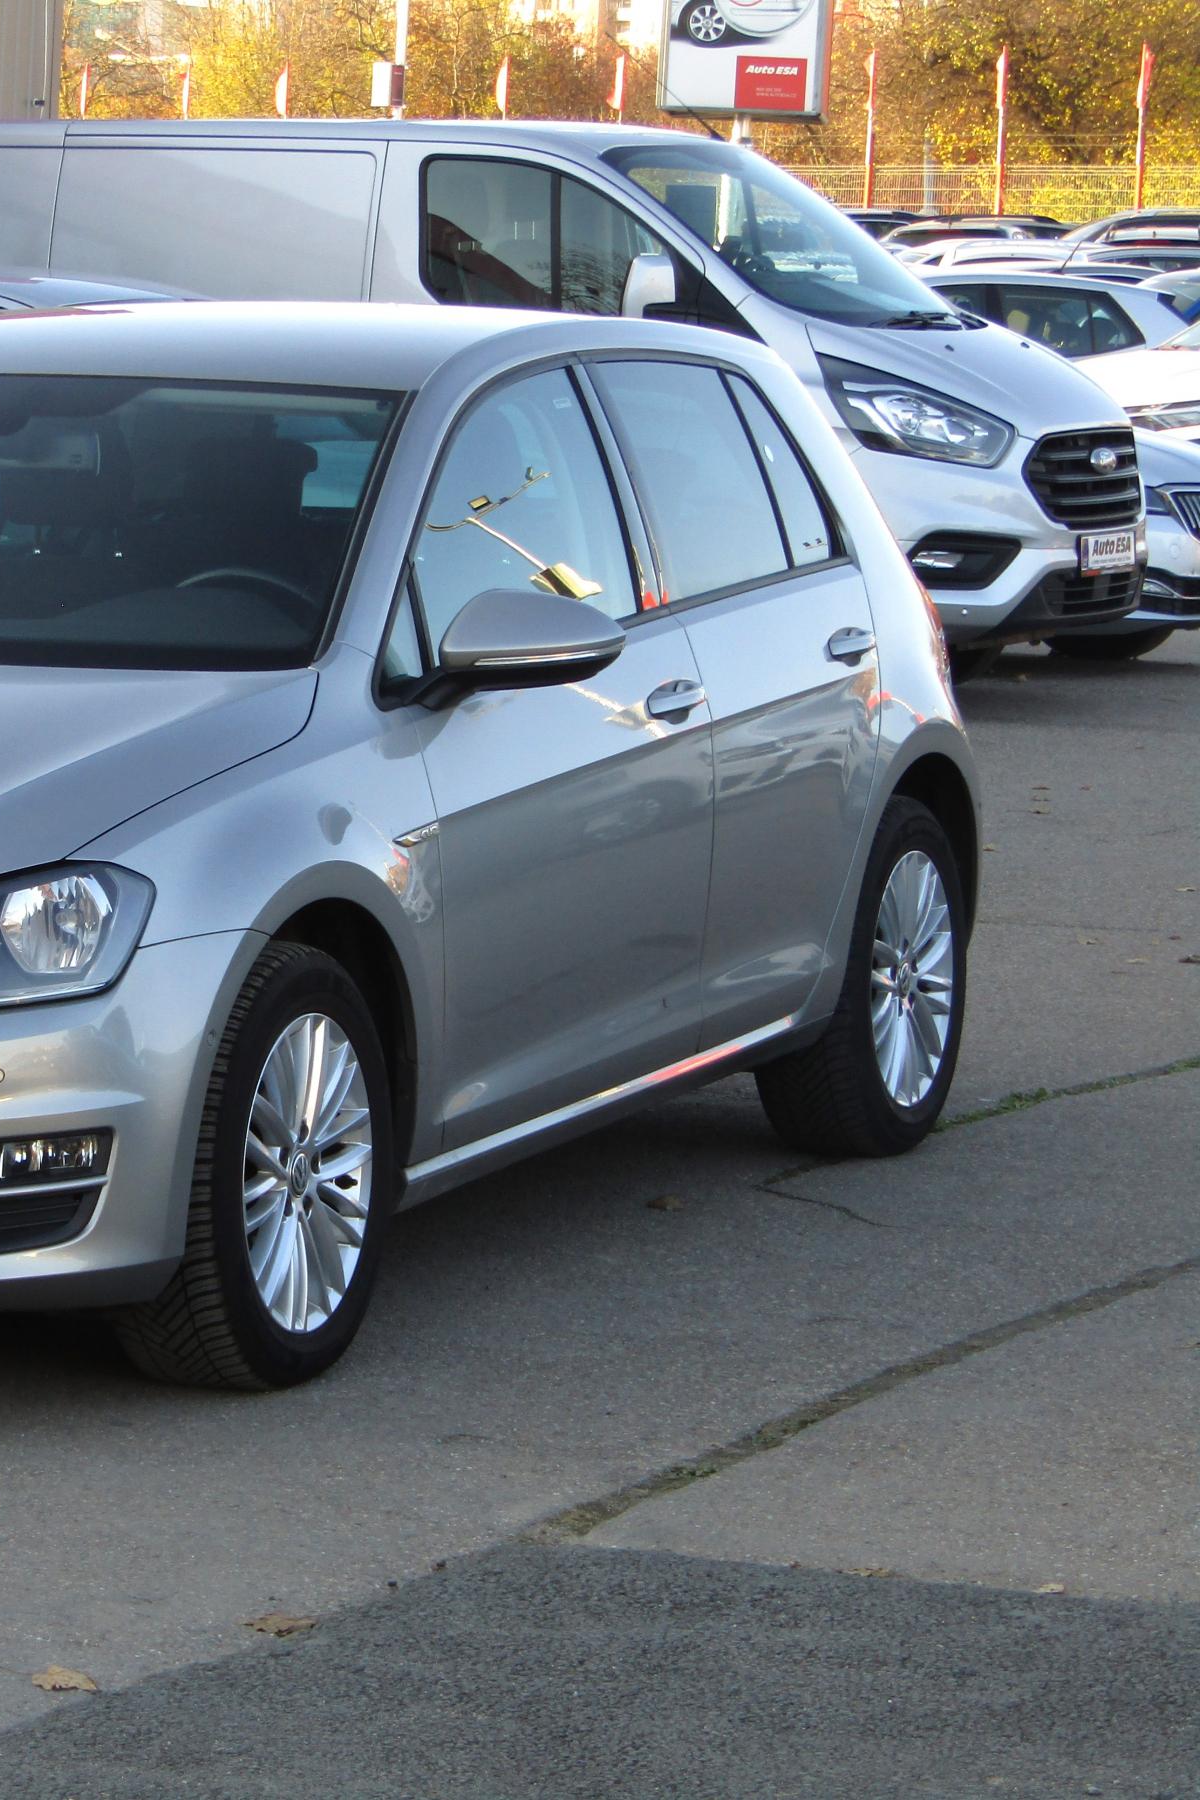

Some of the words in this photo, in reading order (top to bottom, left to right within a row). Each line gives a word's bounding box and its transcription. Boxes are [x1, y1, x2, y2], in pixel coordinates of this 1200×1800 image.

[745, 65, 774, 75] Auto
[775, 66, 798, 76] ESA
[1092, 539, 1115, 556] Auto
[1115, 536, 1131, 554] ESA
